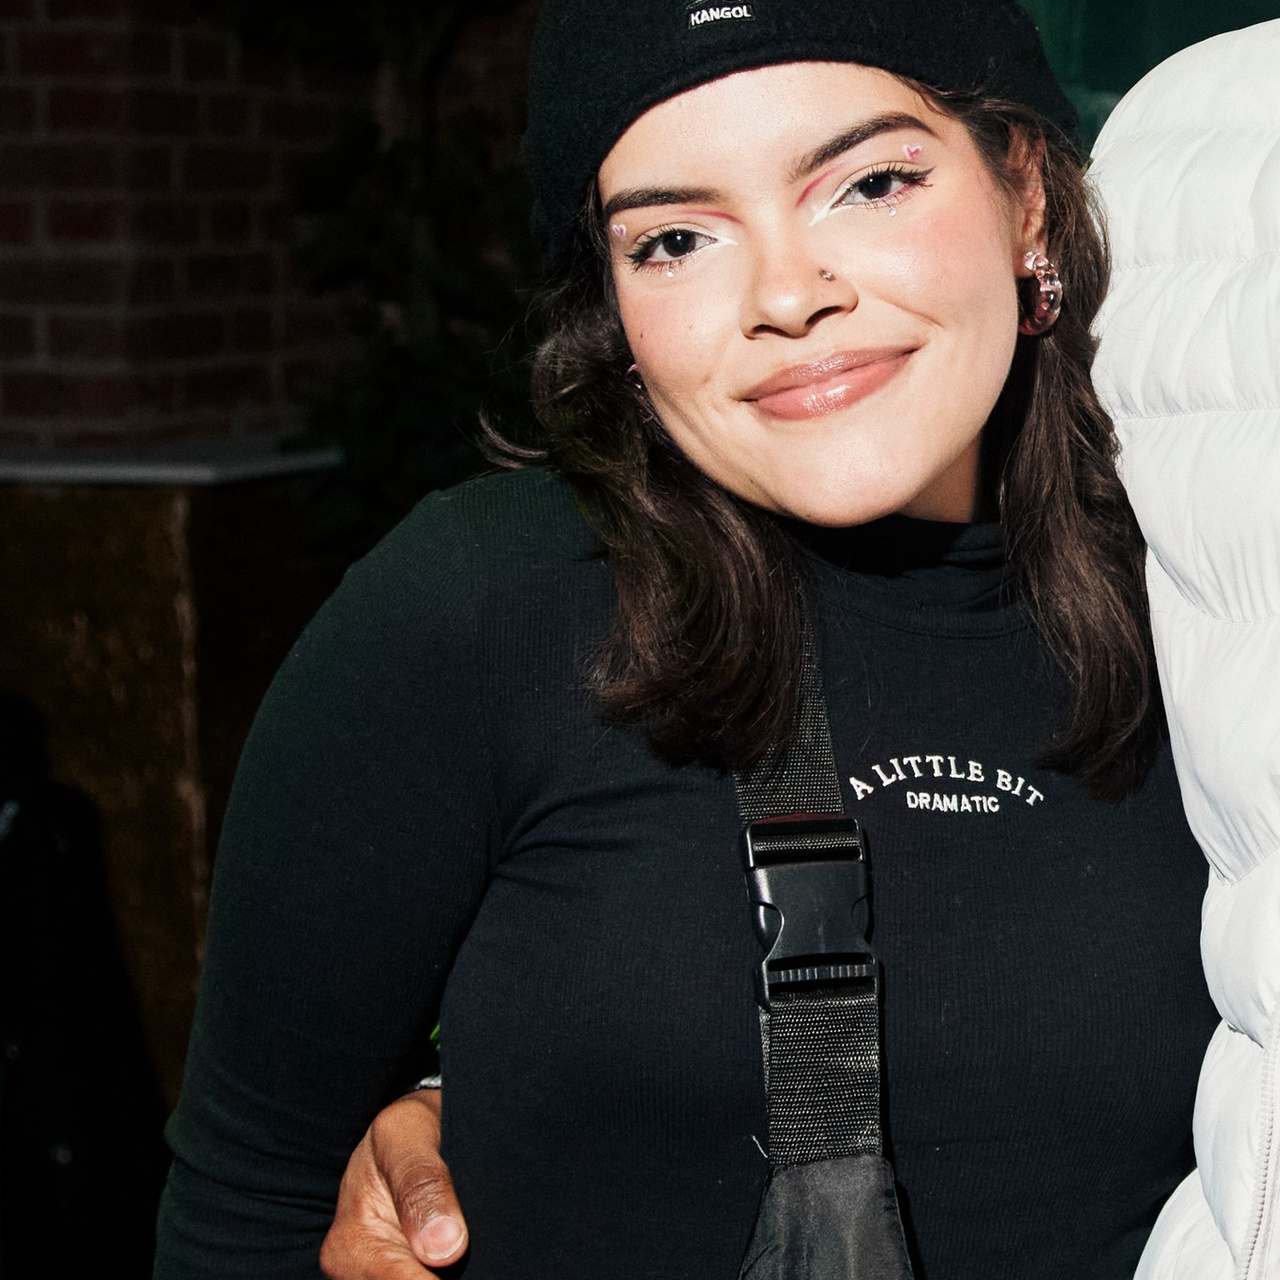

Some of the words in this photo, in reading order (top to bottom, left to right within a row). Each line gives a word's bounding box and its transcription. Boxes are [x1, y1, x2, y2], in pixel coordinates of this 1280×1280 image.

[690, 5, 752, 26] KANGOL
[850, 776, 874, 801] A
[872, 755, 985, 787] LITTLE
[996, 769, 1044, 807] BIT
[906, 791, 1000, 814] DRAMATIC
